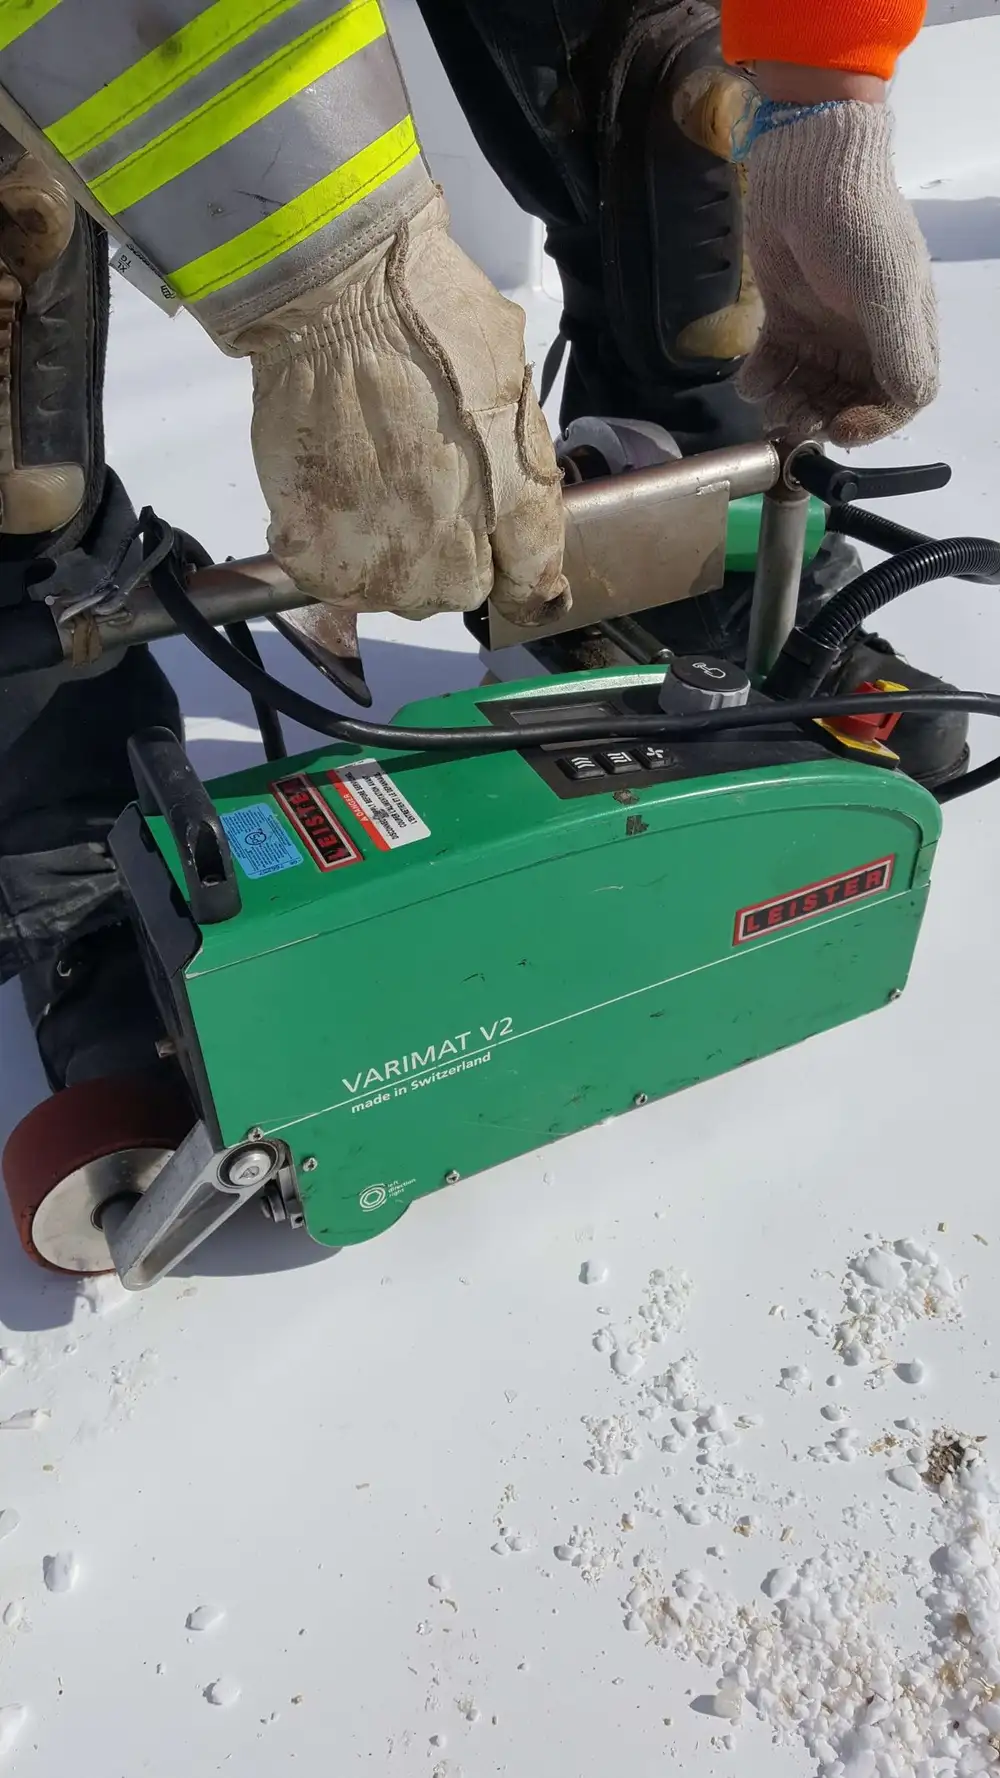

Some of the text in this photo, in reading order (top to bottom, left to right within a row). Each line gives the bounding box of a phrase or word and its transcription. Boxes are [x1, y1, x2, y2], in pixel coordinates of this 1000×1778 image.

[117, 260, 127, 273] XL
[120, 254, 132, 268] TG
[343, 793, 364, 817] DANGER
[283, 779, 348, 861] LEISTER
[391, 812, 407, 828] COUPER
[746, 869, 884, 933] LEISTER
[342, 1016, 514, 1094] VARIMAT V2
[351, 1051, 492, 1113] made in Switzerland
[388, 1178, 417, 1193] direction
